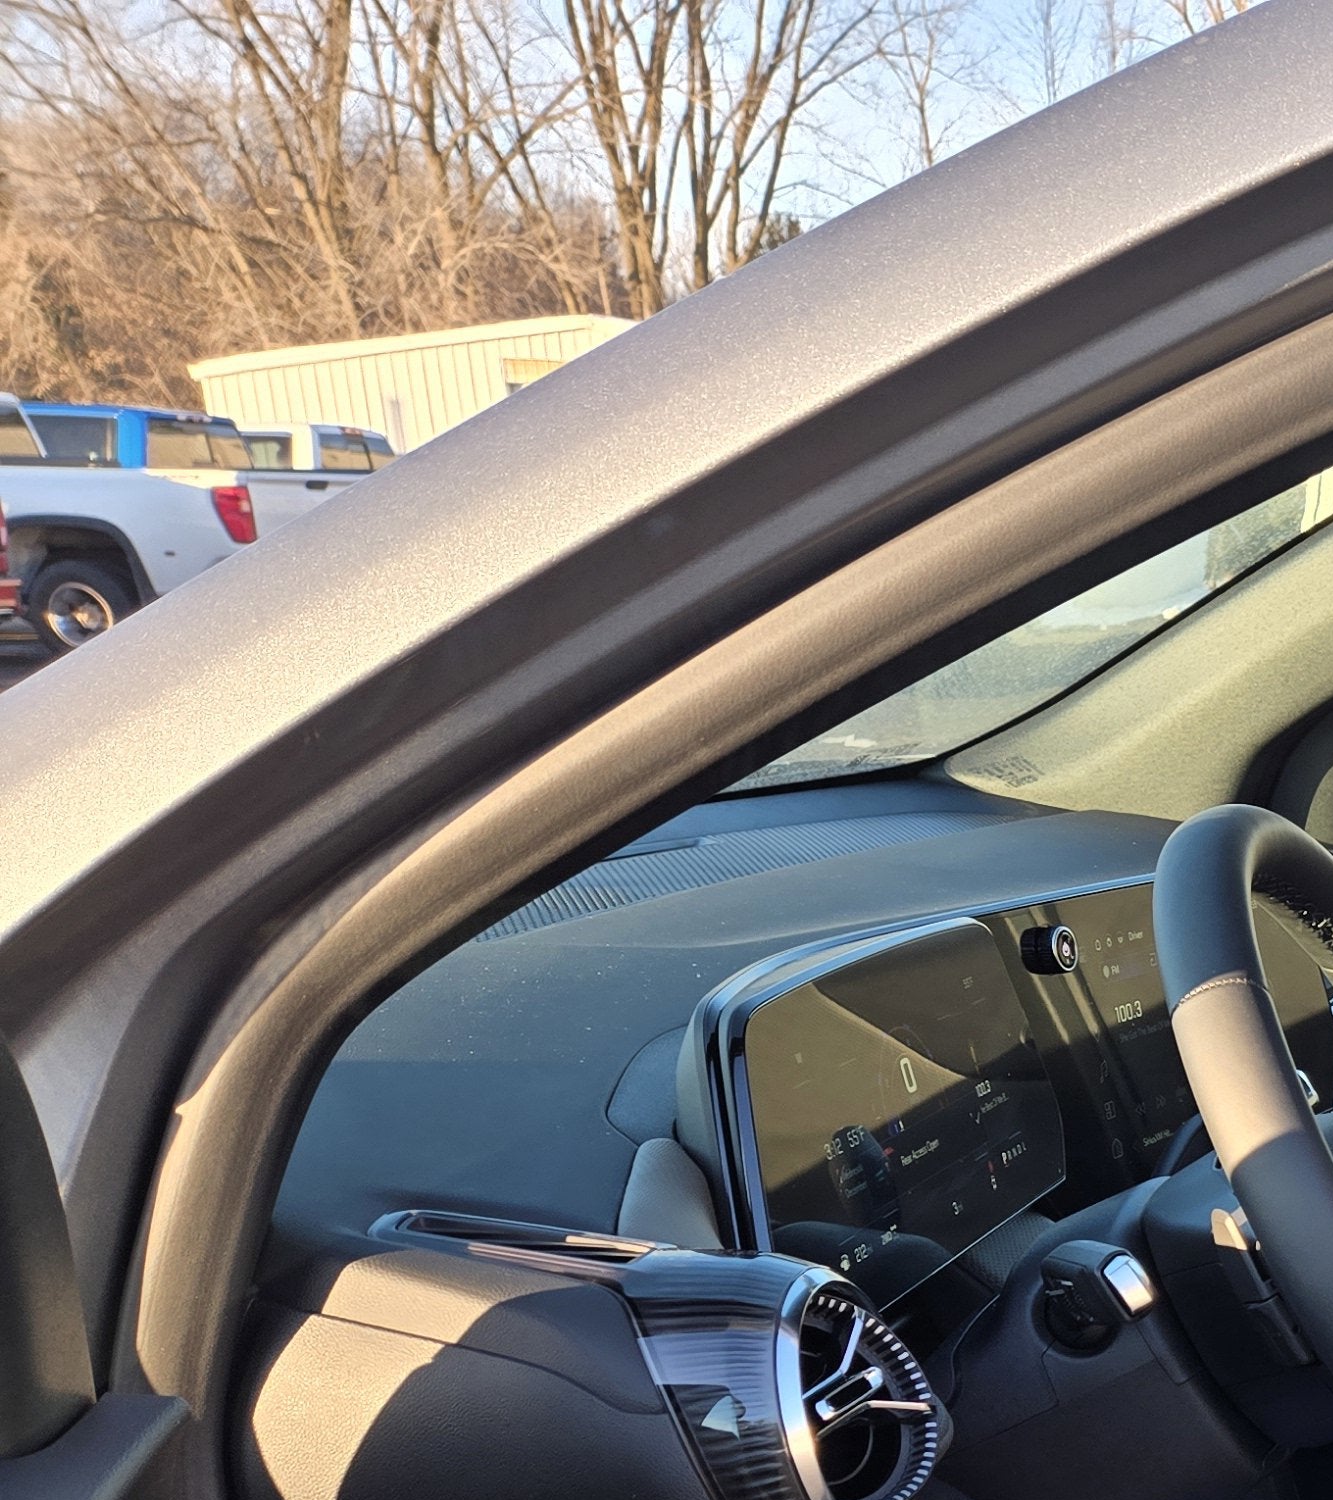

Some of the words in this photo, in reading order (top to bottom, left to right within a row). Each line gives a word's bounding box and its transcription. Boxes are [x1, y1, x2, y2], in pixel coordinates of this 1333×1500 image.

[1115, 1000, 1143, 1023] 100.3
[900, 1057, 918, 1094] 0
[823, 1138, 844, 1160] 3:12
